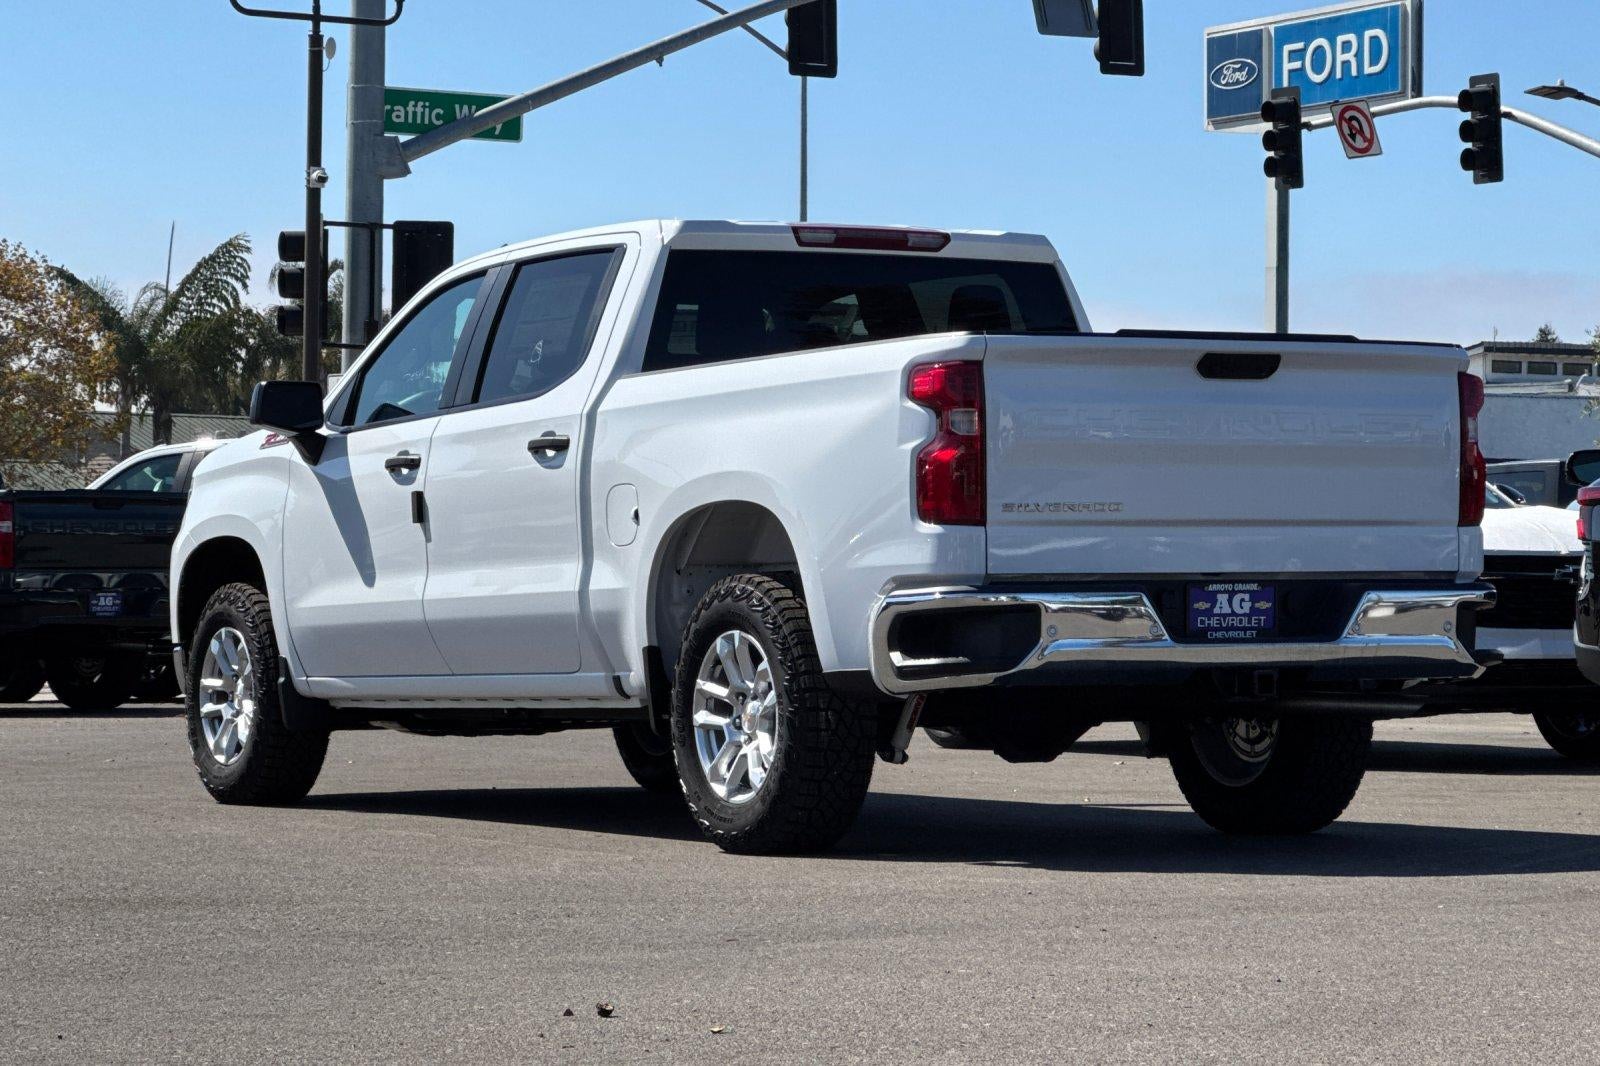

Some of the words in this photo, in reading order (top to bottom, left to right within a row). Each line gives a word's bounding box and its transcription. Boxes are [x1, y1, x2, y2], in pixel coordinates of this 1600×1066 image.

[1282, 28, 1390, 88] FORD
[1220, 63, 1248, 84] Ford
[383, 100, 444, 126] raffic
[1001, 502, 1124, 513] SILVERADO
[1208, 583, 1232, 591] ARROYO
[1234, 583, 1258, 591] GRANDE
[97, 596, 113, 606] AG
[1213, 592, 1252, 614] AG
[1197, 616, 1266, 627] CHEVROLET
[1207, 630, 1257, 639] CHEVROLET
